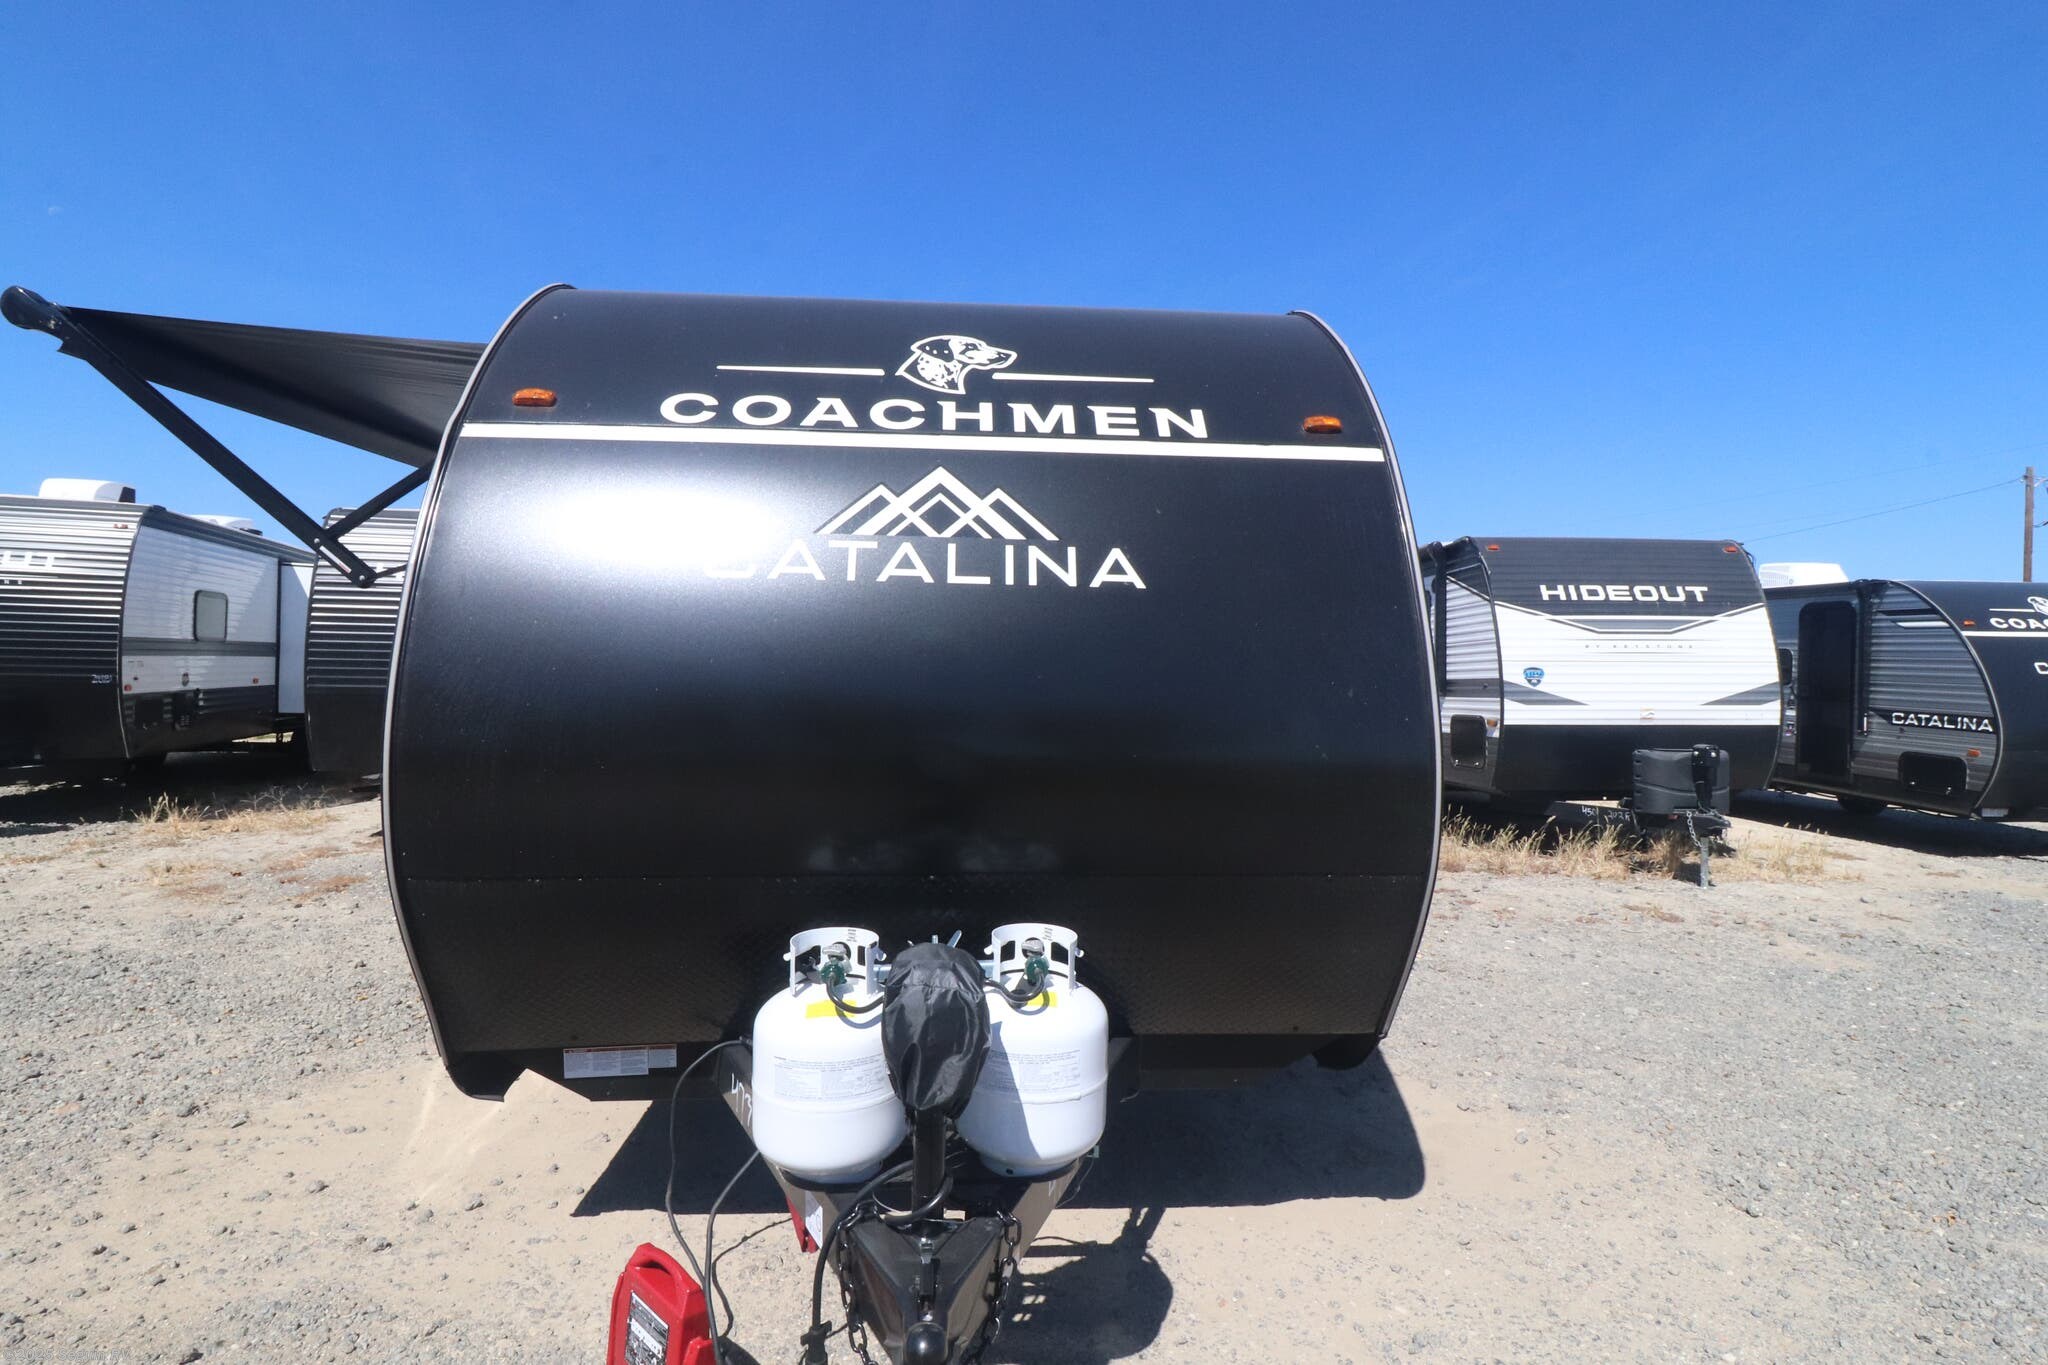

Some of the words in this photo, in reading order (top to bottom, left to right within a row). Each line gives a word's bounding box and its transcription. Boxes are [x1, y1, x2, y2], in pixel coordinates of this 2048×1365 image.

[659, 391, 1209, 439] COACHMEN
[1539, 584, 1709, 603] HIDEOUT
[1989, 617, 2048, 630] COA
[1891, 711, 1994, 733] CATALINA
